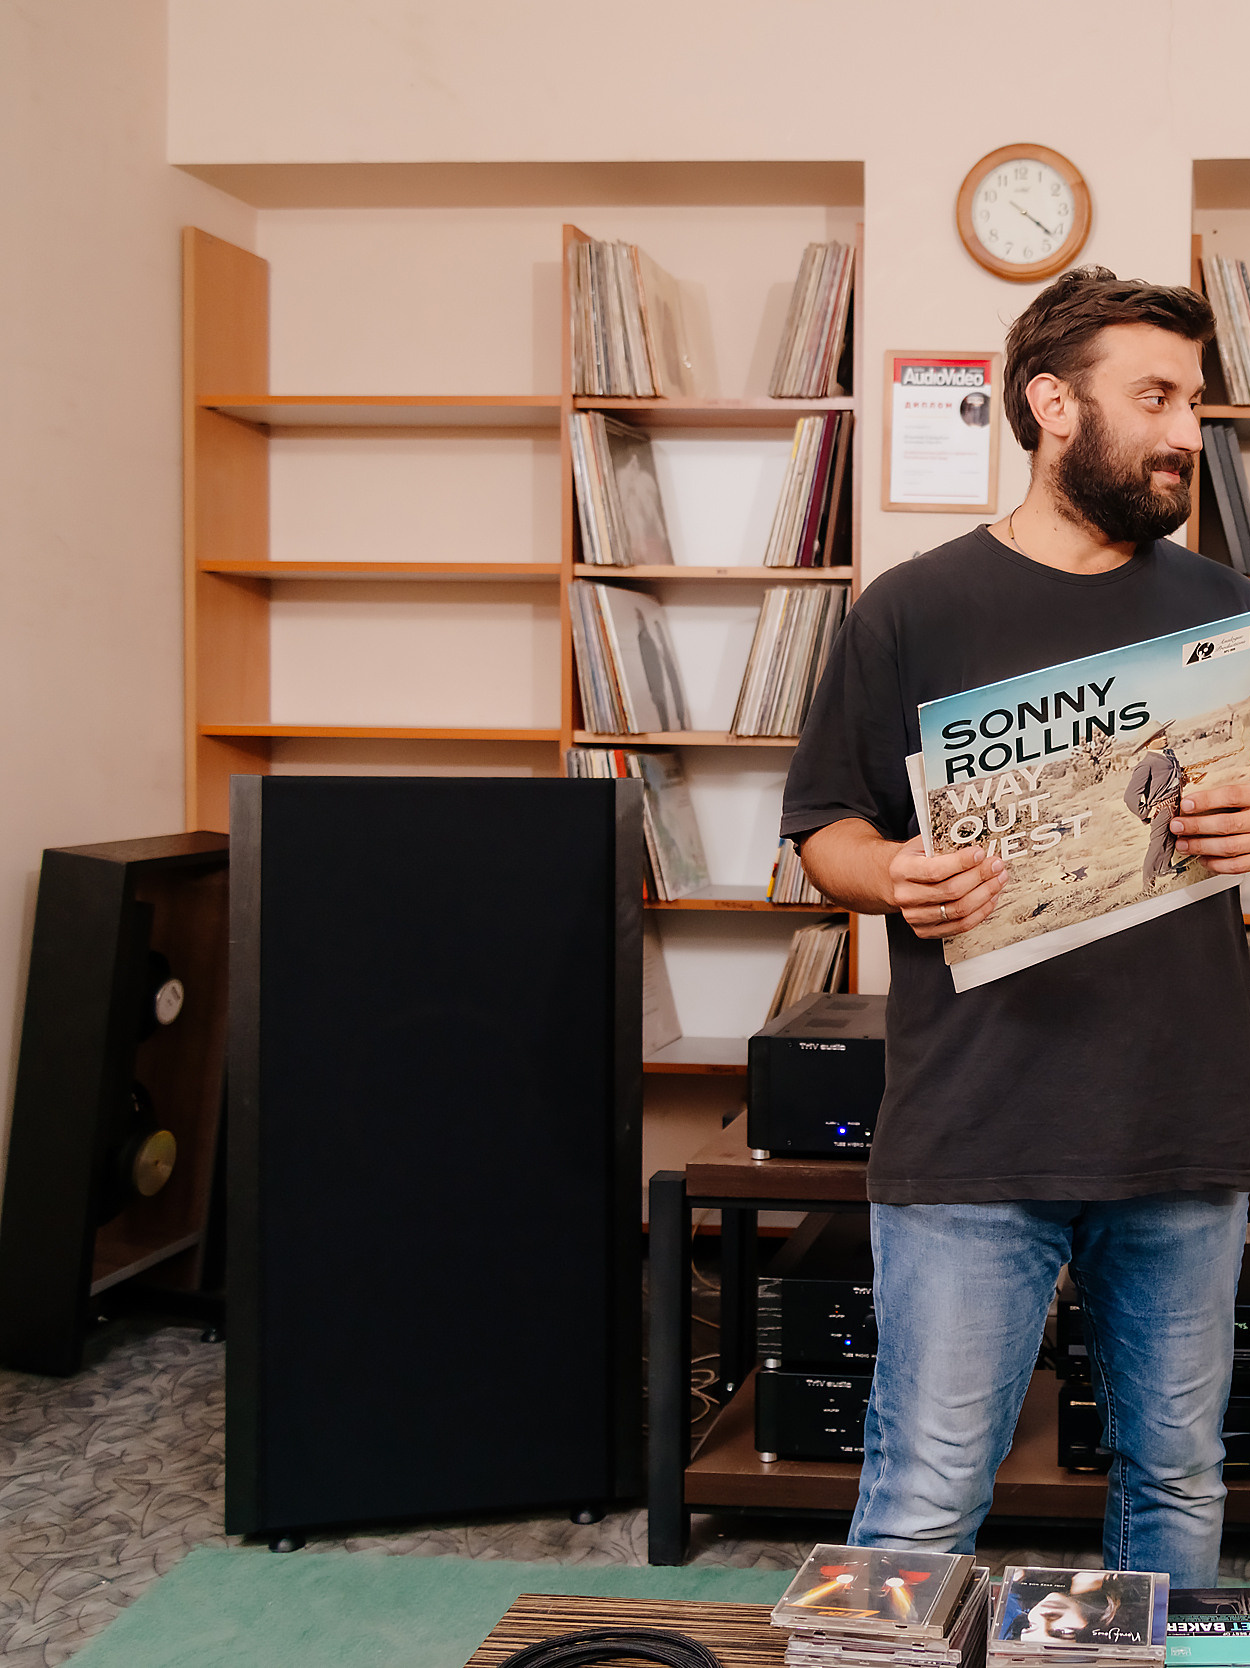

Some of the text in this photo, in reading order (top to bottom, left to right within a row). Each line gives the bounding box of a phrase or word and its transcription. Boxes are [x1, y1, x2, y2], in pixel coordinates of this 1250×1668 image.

[1014, 167, 1028, 180] 12
[1038, 170, 1042, 183] 1
[998, 175, 1008, 187] 11
[1051, 183, 1061, 197] 2
[984, 191, 997, 203] 10
[980, 210, 990, 222] 9
[1058, 203, 1069, 216] 3
[989, 229, 999, 242] 8
[1053, 223, 1064, 235] 4
[1005, 242, 1015, 255] 7
[1023, 245, 1034, 258] 6
[1042, 239, 1052, 252] 5
[903, 366, 984, 387] AudioVideo
[941, 676, 1116, 750] SONNY
[945, 701, 1151, 785] ROLLINS
[946, 763, 1045, 814] WAY
[950, 792, 1051, 844] OUT
[1167, 1621, 1226, 1632] BAKER
